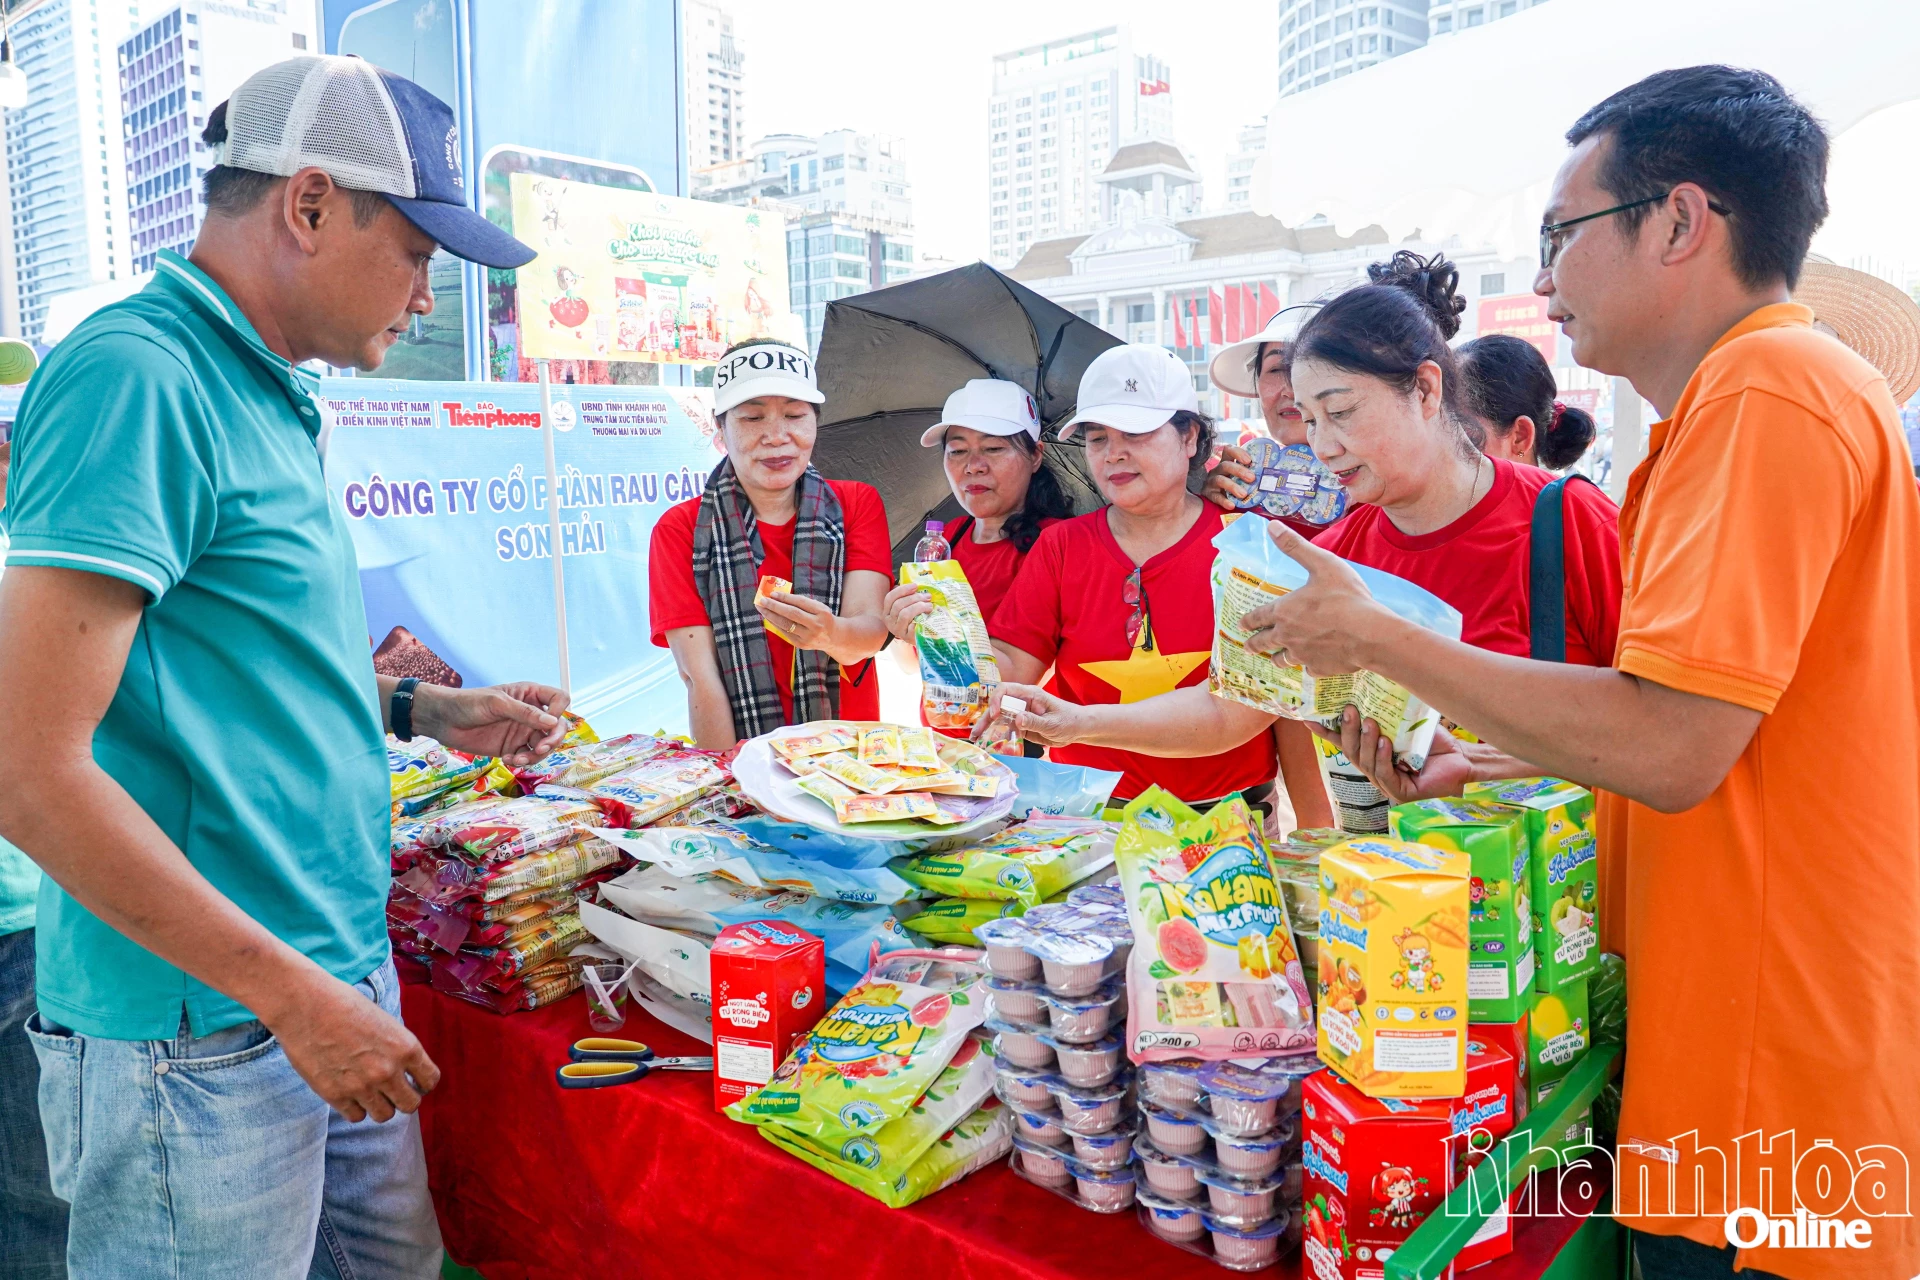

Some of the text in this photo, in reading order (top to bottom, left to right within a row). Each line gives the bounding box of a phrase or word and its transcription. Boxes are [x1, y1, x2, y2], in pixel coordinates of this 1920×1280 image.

[717, 351, 812, 389] SPORT
[366, 416, 389, 427] KINH
[390, 414, 409, 429] VIỆT
[411, 416, 432, 427] NAM
[367, 401, 389, 412] THAO
[391, 400, 408, 414] VIỆT
[410, 401, 431, 412] NAM
[346, 475, 434, 518] CÔNG
[442, 479, 479, 513] TY
[488, 465, 528, 512] CỔ
[612, 473, 658, 504] RAU
[663, 465, 706, 502] CÂU
[498, 514, 606, 561] SƠN HẢI
